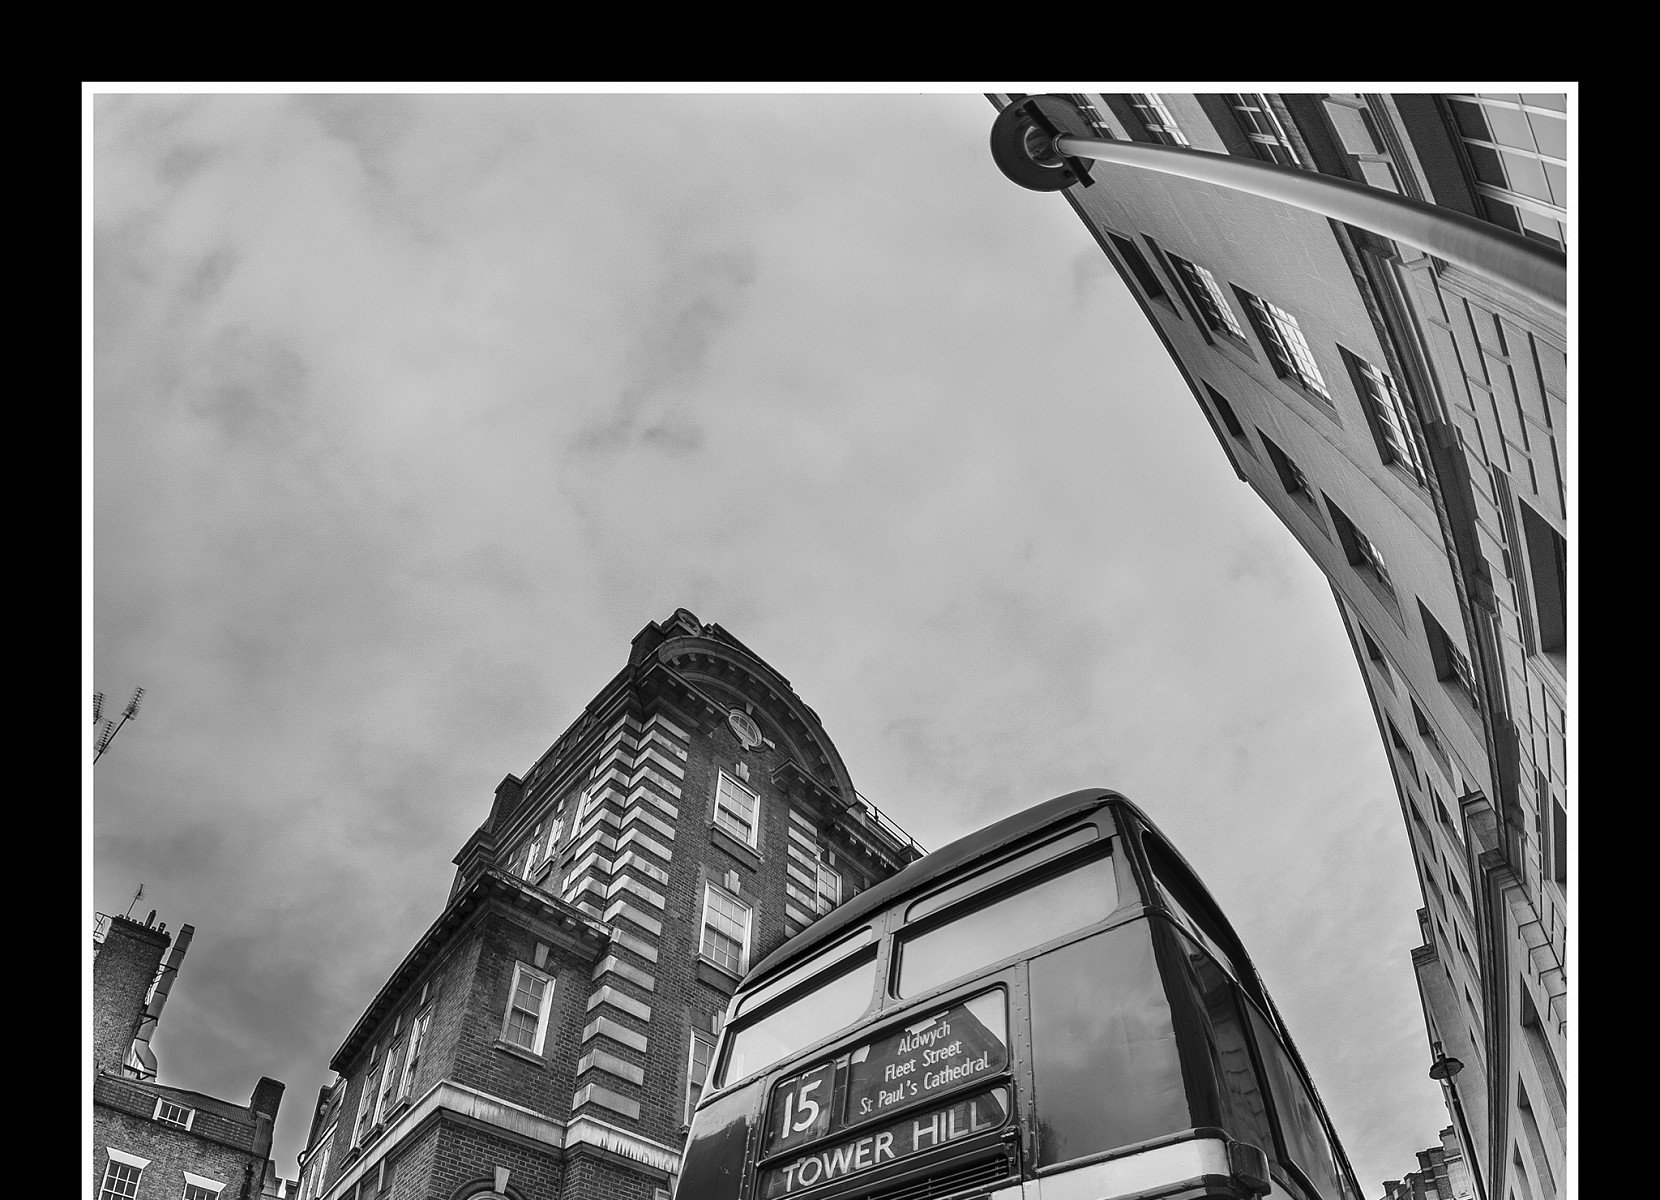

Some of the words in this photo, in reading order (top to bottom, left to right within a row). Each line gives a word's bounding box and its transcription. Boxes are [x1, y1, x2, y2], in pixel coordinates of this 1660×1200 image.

[884, 1059, 917, 1083] Fleet
[922, 1039, 963, 1066] Street
[898, 1021, 951, 1055] Aldwych
[781, 1079, 823, 1140] 15
[859, 1097, 874, 1116] St
[878, 1079, 919, 1109] Paul's
[923, 1051, 991, 1091] Cathedral
[782, 1131, 896, 1193] TOWER
[912, 1101, 992, 1151] HILL
